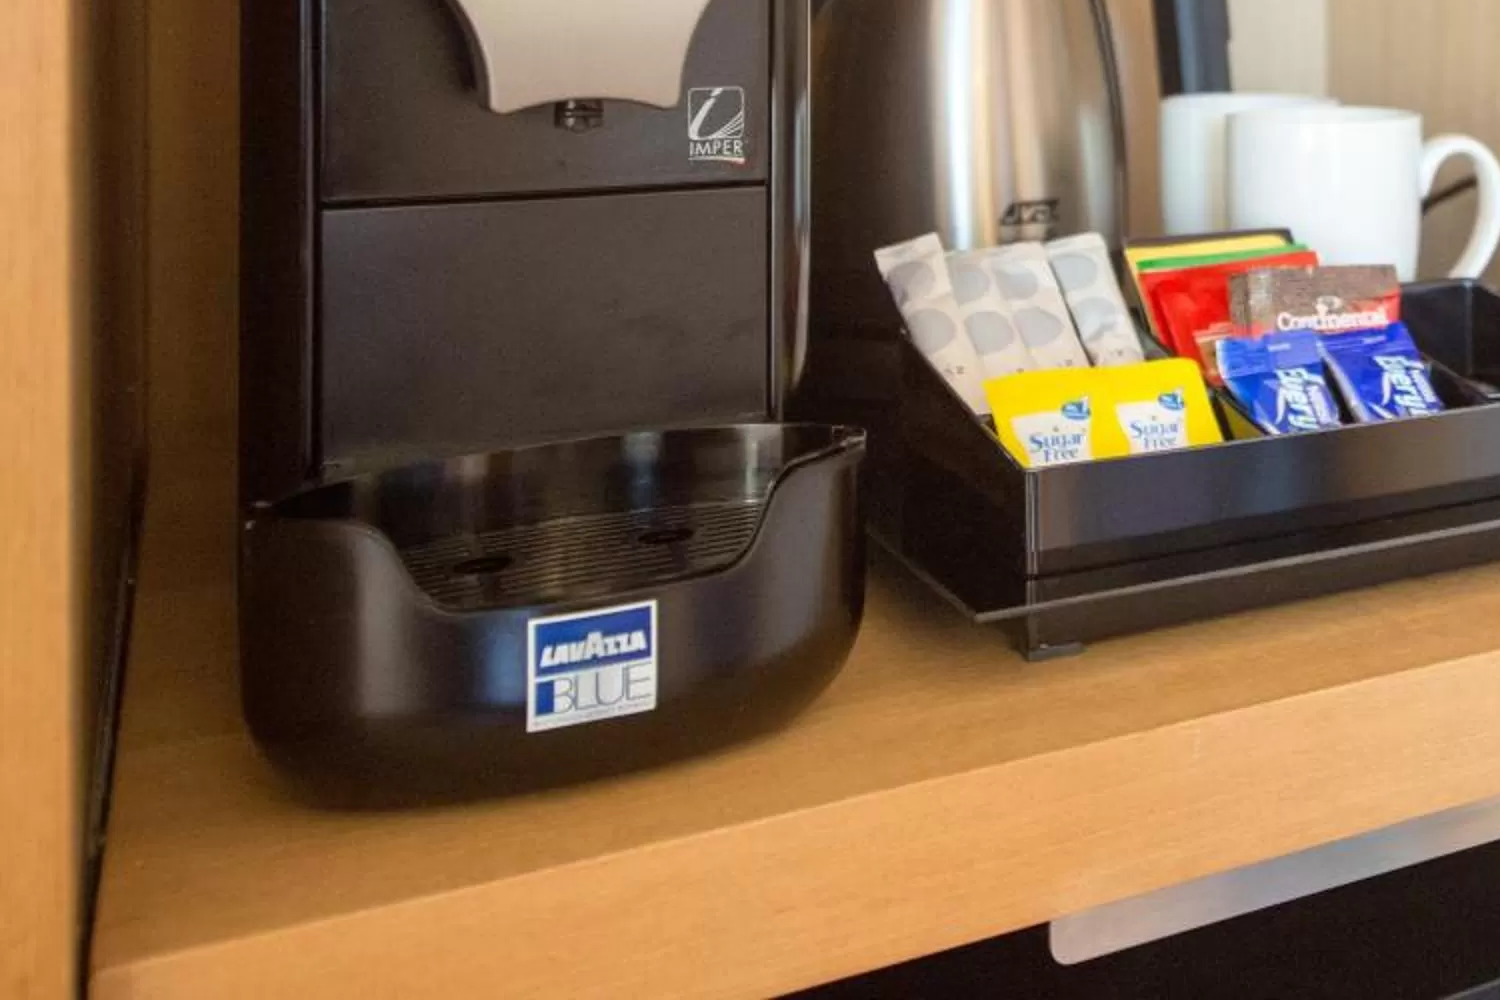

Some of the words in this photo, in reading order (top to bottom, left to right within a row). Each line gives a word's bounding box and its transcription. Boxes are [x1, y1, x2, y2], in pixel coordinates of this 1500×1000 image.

[689, 140, 743, 156] IMPER
[1276, 304, 1390, 332] Continental
[1129, 419, 1178, 439] Sugar
[1029, 431, 1083, 452] Sugar
[1143, 436, 1176, 450] Free
[1044, 448, 1079, 463] Free
[539, 630, 647, 669] LAVAZZA
[535, 661, 652, 716] BLUE
